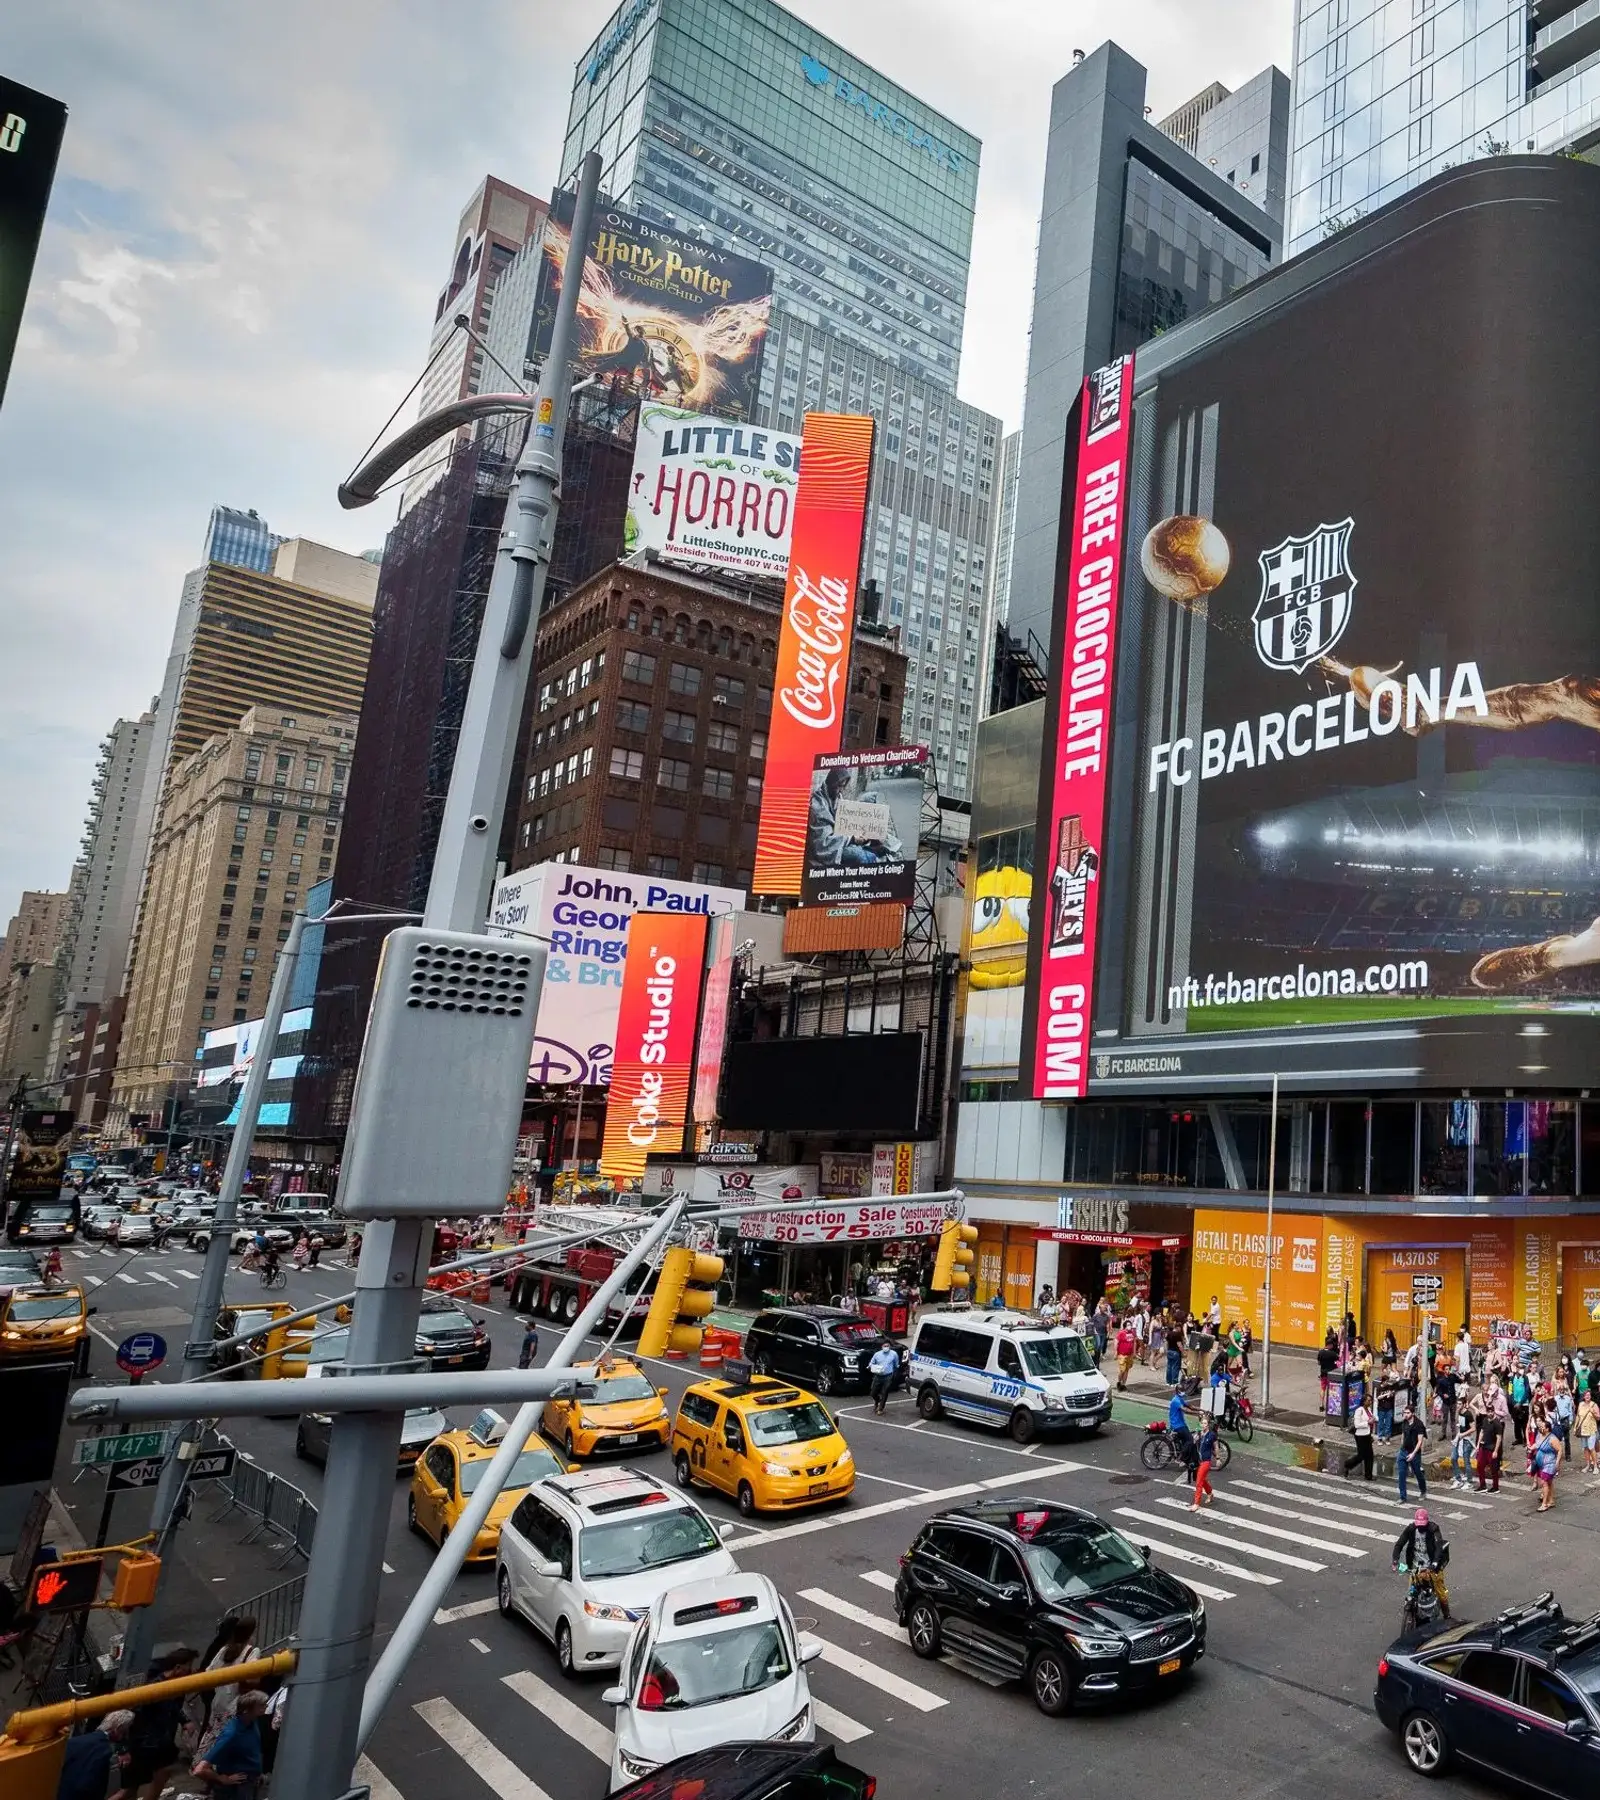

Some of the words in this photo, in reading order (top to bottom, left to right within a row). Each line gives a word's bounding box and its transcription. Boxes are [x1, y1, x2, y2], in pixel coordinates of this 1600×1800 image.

[835, 79, 964, 173] BARCLAYS
[606, 213, 633, 230] ON
[640, 225, 727, 264] BROADWAY
[591, 232, 663, 275] Harry
[664, 250, 732, 299] Potter
[619, 270, 664, 291] CURSED
[668, 287, 703, 304] CHILD
[662, 427, 768, 461] LITTLE
[740, 464, 760, 476] OF
[1081, 459, 1121, 554] FREE
[665, 543, 706, 558] Westside
[708, 551, 742, 564] Theatre
[744, 557, 761, 567] 407
[763, 562, 772, 570] W
[1065, 555, 1114, 781] CHOCOLATE
[1149, 736, 1192, 792] FC
[1201, 662, 1489, 781] BARCELONA
[820, 753, 851, 768] Donating
[851, 754, 859, 764] to
[860, 753, 885, 763] Veteran
[886, 749, 919, 760] Charities?
[809, 868, 826, 878] Know
[826, 867, 845, 877] Where
[845, 866, 858, 876] Your
[858, 865, 878, 877] Money
[878, 865, 884, 874] is
[885, 864, 905, 876] Going?
[497, 885, 521, 905] Where
[558, 874, 639, 907] John,
[852, 880, 865, 888] More
[507, 904, 529, 925] Story
[829, 908, 859, 916] LAMAR
[546, 959, 570, 983] &
[1168, 960, 1429, 1010] nft.fcbarcelona.com
[640, 956, 677, 1064] Studio
[1112, 1059, 1124, 1073] FC
[1125, 1057, 1181, 1073] BARCELONA
[627, 1072, 664, 1145] Coke
[830, 1165, 868, 1186] GIFTS
[897, 1144, 910, 1195] LUGGAG
[771, 1211, 846, 1225] Construction
[859, 1207, 896, 1221] Sale
[901, 1206, 941, 1219] Construction
[1058, 1197, 1129, 1234] HERSHEY'S
[872, 1229, 896, 1237] OFF
[1051, 1232, 1080, 1241] HERSHEY'S
[1080, 1234, 1112, 1243] CHOCOLATE
[1113, 1236, 1133, 1245] WORLD
[1196, 1231, 1229, 1251] RETAIL
[1233, 1234, 1284, 1254] FLAGSIP
[1195, 1251, 1225, 1264] SPACE
[1228, 1254, 1248, 1266] FOR
[1345, 1236, 1355, 1270] LEASE
[1392, 1252, 1425, 1267] 14,370
[1427, 1252, 1440, 1265] SF
[1525, 1233, 1540, 1291] FLAGSHIP
[1541, 1232, 1551, 1272] LEASE
[1327, 1235, 1342, 1294] FLAGSHIP
[1541, 1271, 1551, 1296] FOR
[1584, 1291, 1600, 1300] 705
[1541, 1299, 1551, 1336] SPACE
[991, 1381, 1020, 1399] NYPD
[103, 1440, 118, 1458] W
[121, 1437, 145, 1455] 47
[130, 1467, 161, 1480] ONE
